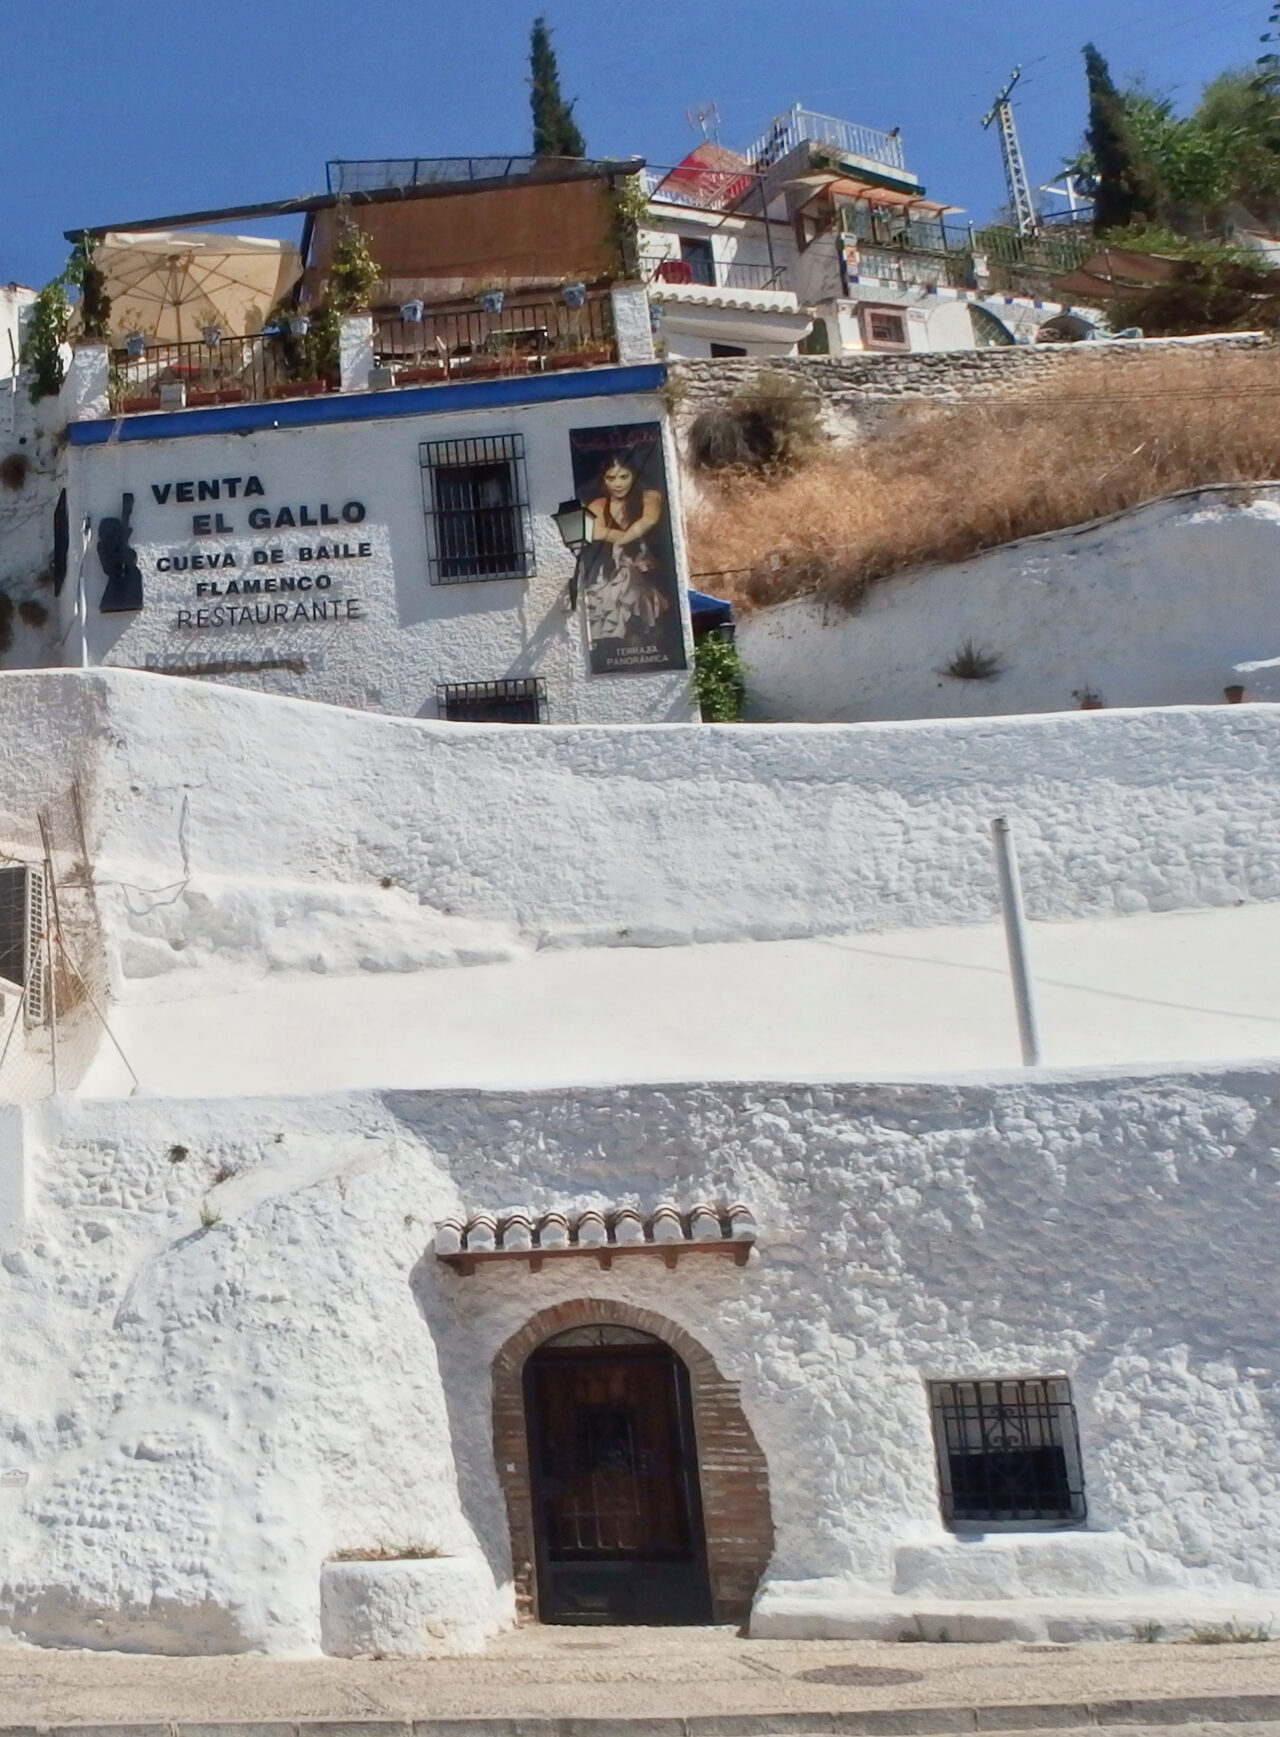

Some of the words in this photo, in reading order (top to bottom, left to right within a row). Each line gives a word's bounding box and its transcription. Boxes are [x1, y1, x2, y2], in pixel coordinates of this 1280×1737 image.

[151, 475, 265, 505] VENTA
[192, 513, 234, 536] EL
[248, 501, 366, 530] GALLO
[156, 553, 236, 572] CUEVA
[253, 549, 284, 565] DE
[299, 542, 373, 562] BAILE
[196, 574, 332, 597] FLAMENCO
[177, 598, 361, 630] RESTAURANTE
[615, 645, 659, 657] TERRAZA
